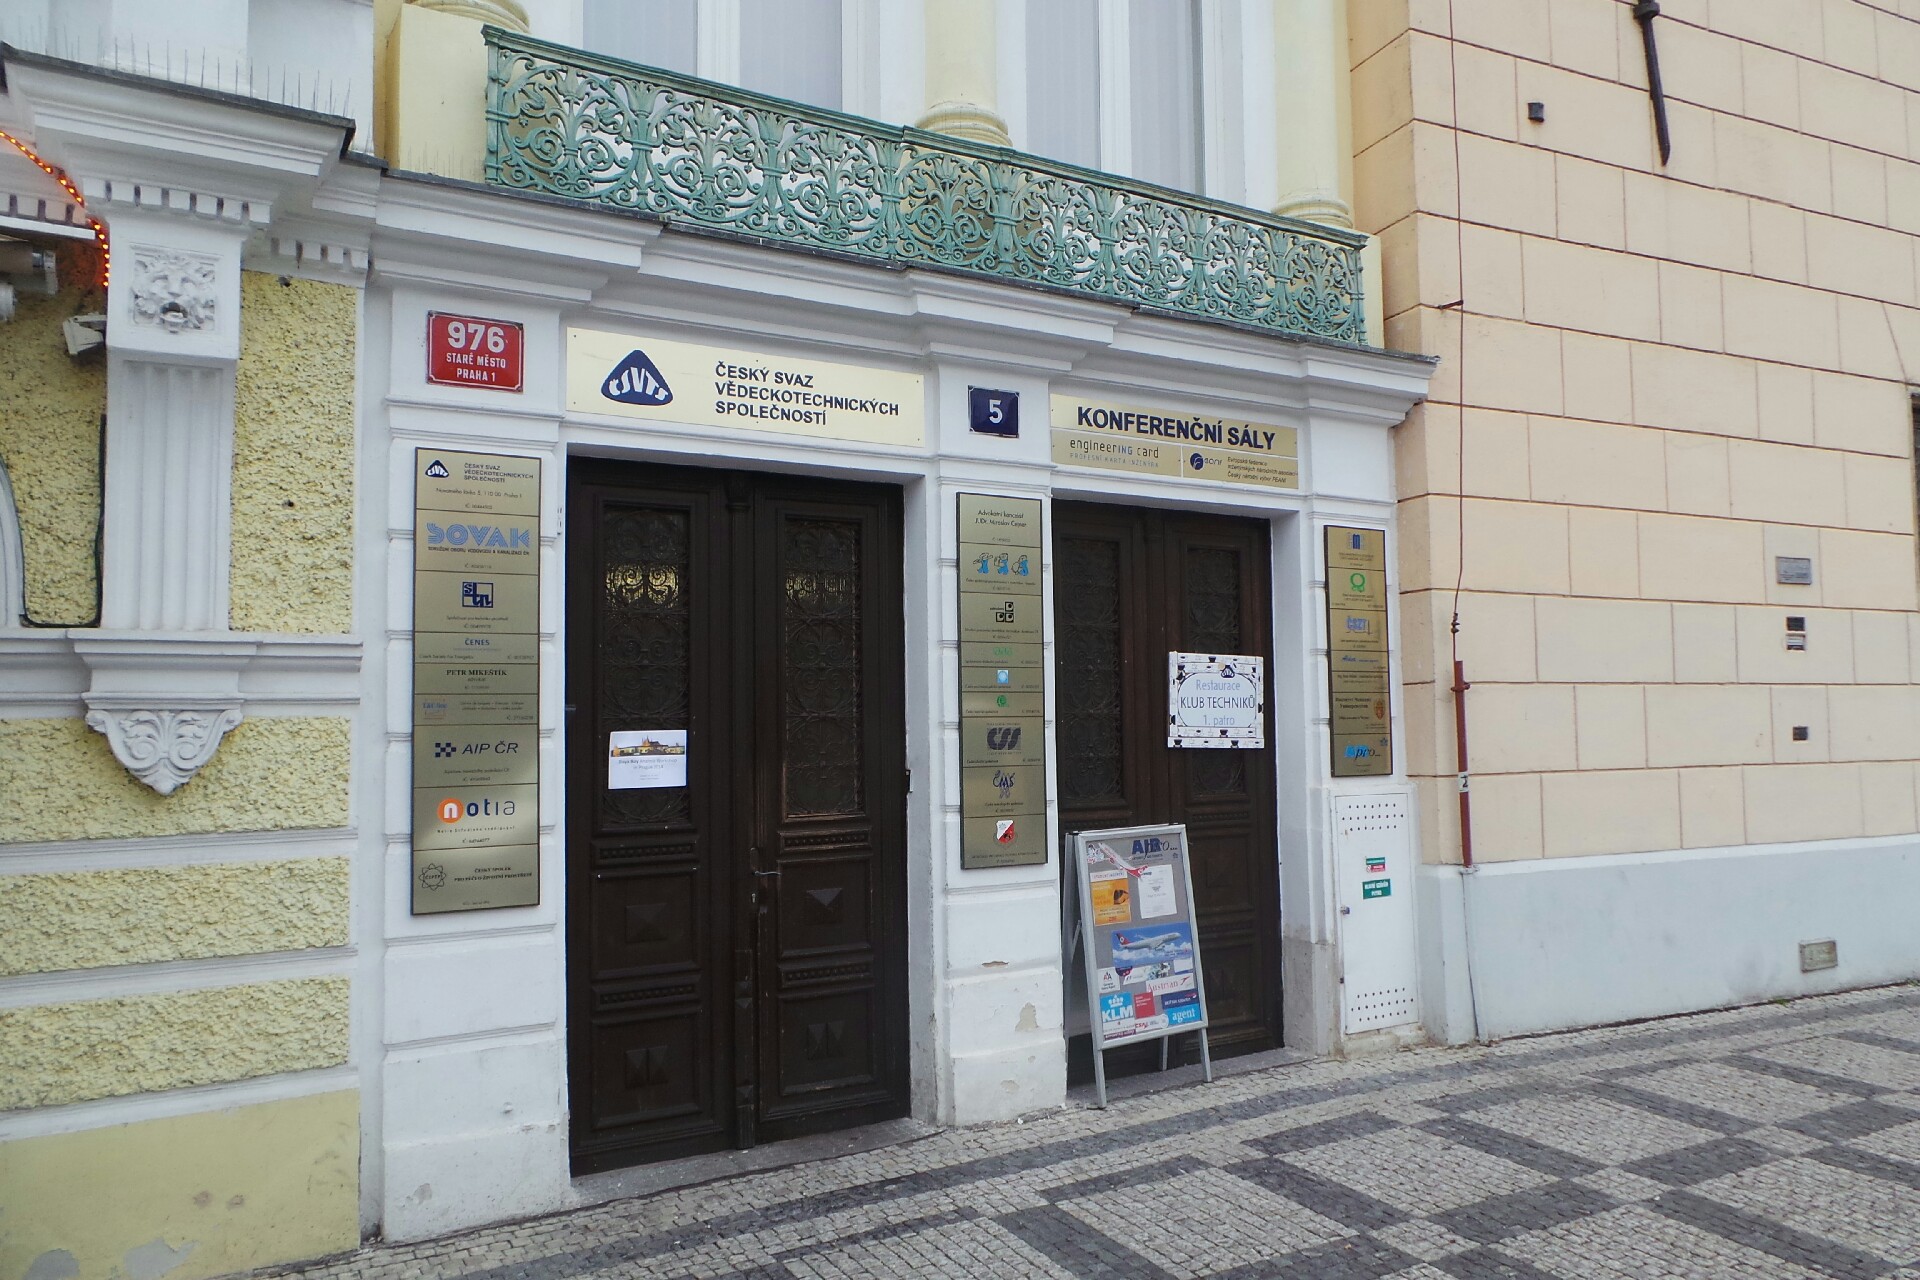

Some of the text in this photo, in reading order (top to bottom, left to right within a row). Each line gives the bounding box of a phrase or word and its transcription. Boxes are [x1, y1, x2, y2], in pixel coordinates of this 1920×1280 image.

[447, 321, 505, 354] 976
[445, 352, 507, 370] STARÉ MĚSTO
[456, 366, 497, 382] PRAHA 1
[715, 360, 814, 388] ČESKÝ SVAZ
[715, 381, 899, 417] VĚDECKOTECHNICKÝCH
[715, 400, 827, 426] SPOLEČNOSTÍ
[989, 399, 1004, 425] 5
[1077, 405, 1275, 450] KONFERENČNÍ SÁLY
[1137, 446, 1159, 459] card
[464, 461, 484, 470] ČESKÝ
[464, 468, 534, 479] VĚDECKOTECHNICKÝCH
[427, 522, 531, 549] SOVAK
[465, 638, 490, 646] ČENES
[1196, 679, 1241, 691] Restaurace
[1180, 695, 1256, 709] KLUB TECHNIKŮ
[1203, 714, 1235, 727] 1. patro
[462, 740, 519, 755] AIP ČR
[1102, 1005, 1134, 1022] KLM
[1172, 1008, 1196, 1023] agent
